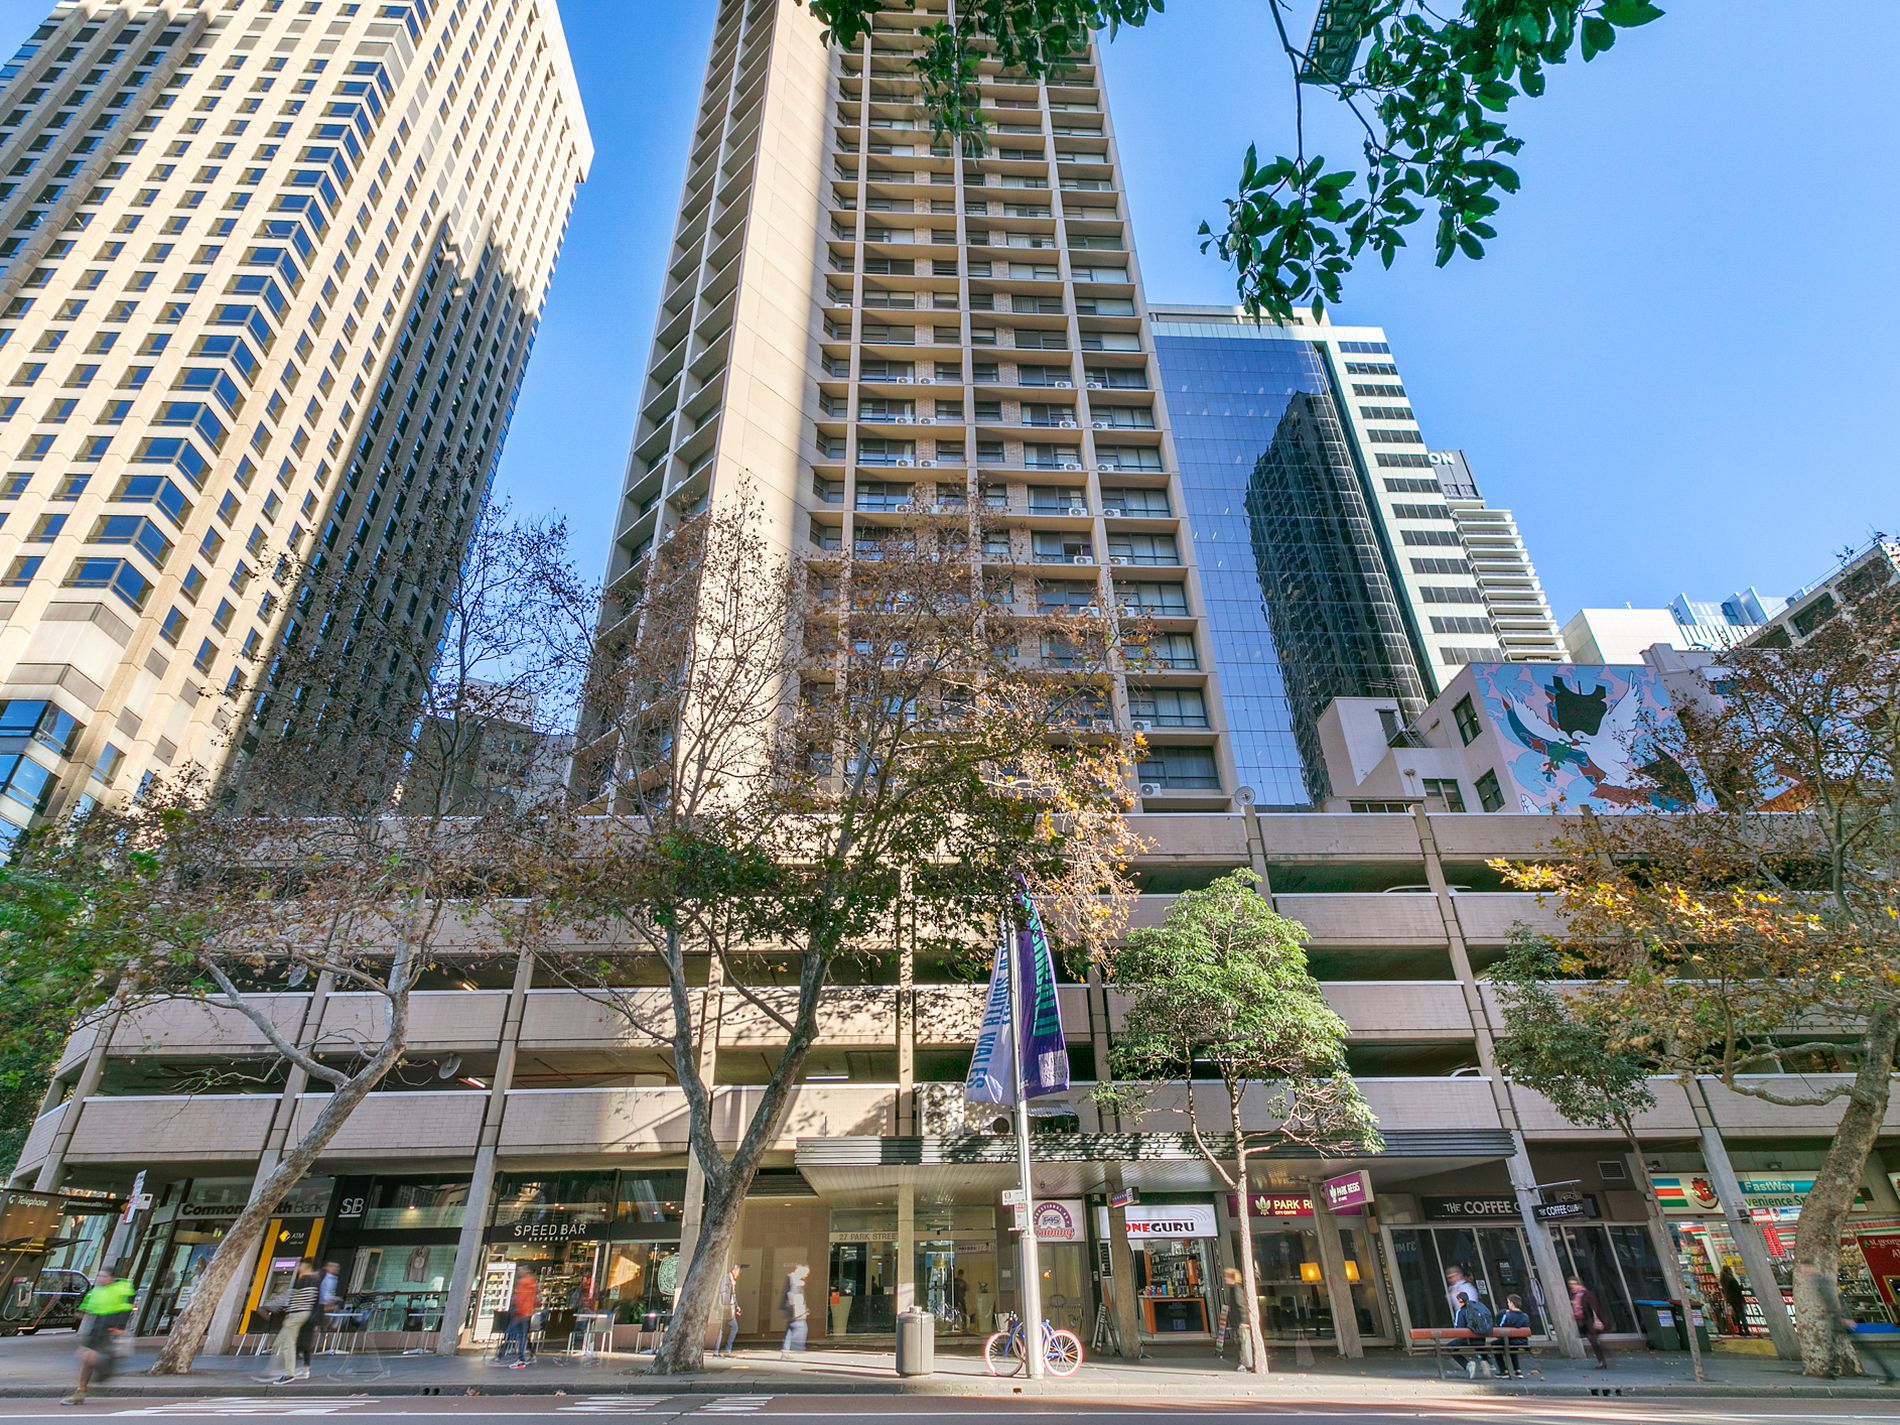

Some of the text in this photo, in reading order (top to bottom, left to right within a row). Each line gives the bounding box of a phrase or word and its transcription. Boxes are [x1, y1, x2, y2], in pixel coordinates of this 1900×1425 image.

[966, 1030, 997, 1090] WALES
[1744, 1181, 1795, 1193] FastWay
[17, 1195, 49, 1208] Telephone
[339, 1197, 365, 1214] SB
[1273, 1199, 1300, 1209] PARK
[1744, 1195, 1793, 1206] venience
[182, 1200, 324, 1216] Commonth Bank
[1443, 1202, 1461, 1213] THE
[1463, 1201, 1513, 1214] COFFEE
[1546, 1204, 1567, 1216] COFFEE
[513, 1223, 587, 1237] SPEED BAR
[1125, 1221, 1195, 1233] ONEGURU
[838, 1230, 898, 1241] 27 PARK STREE
